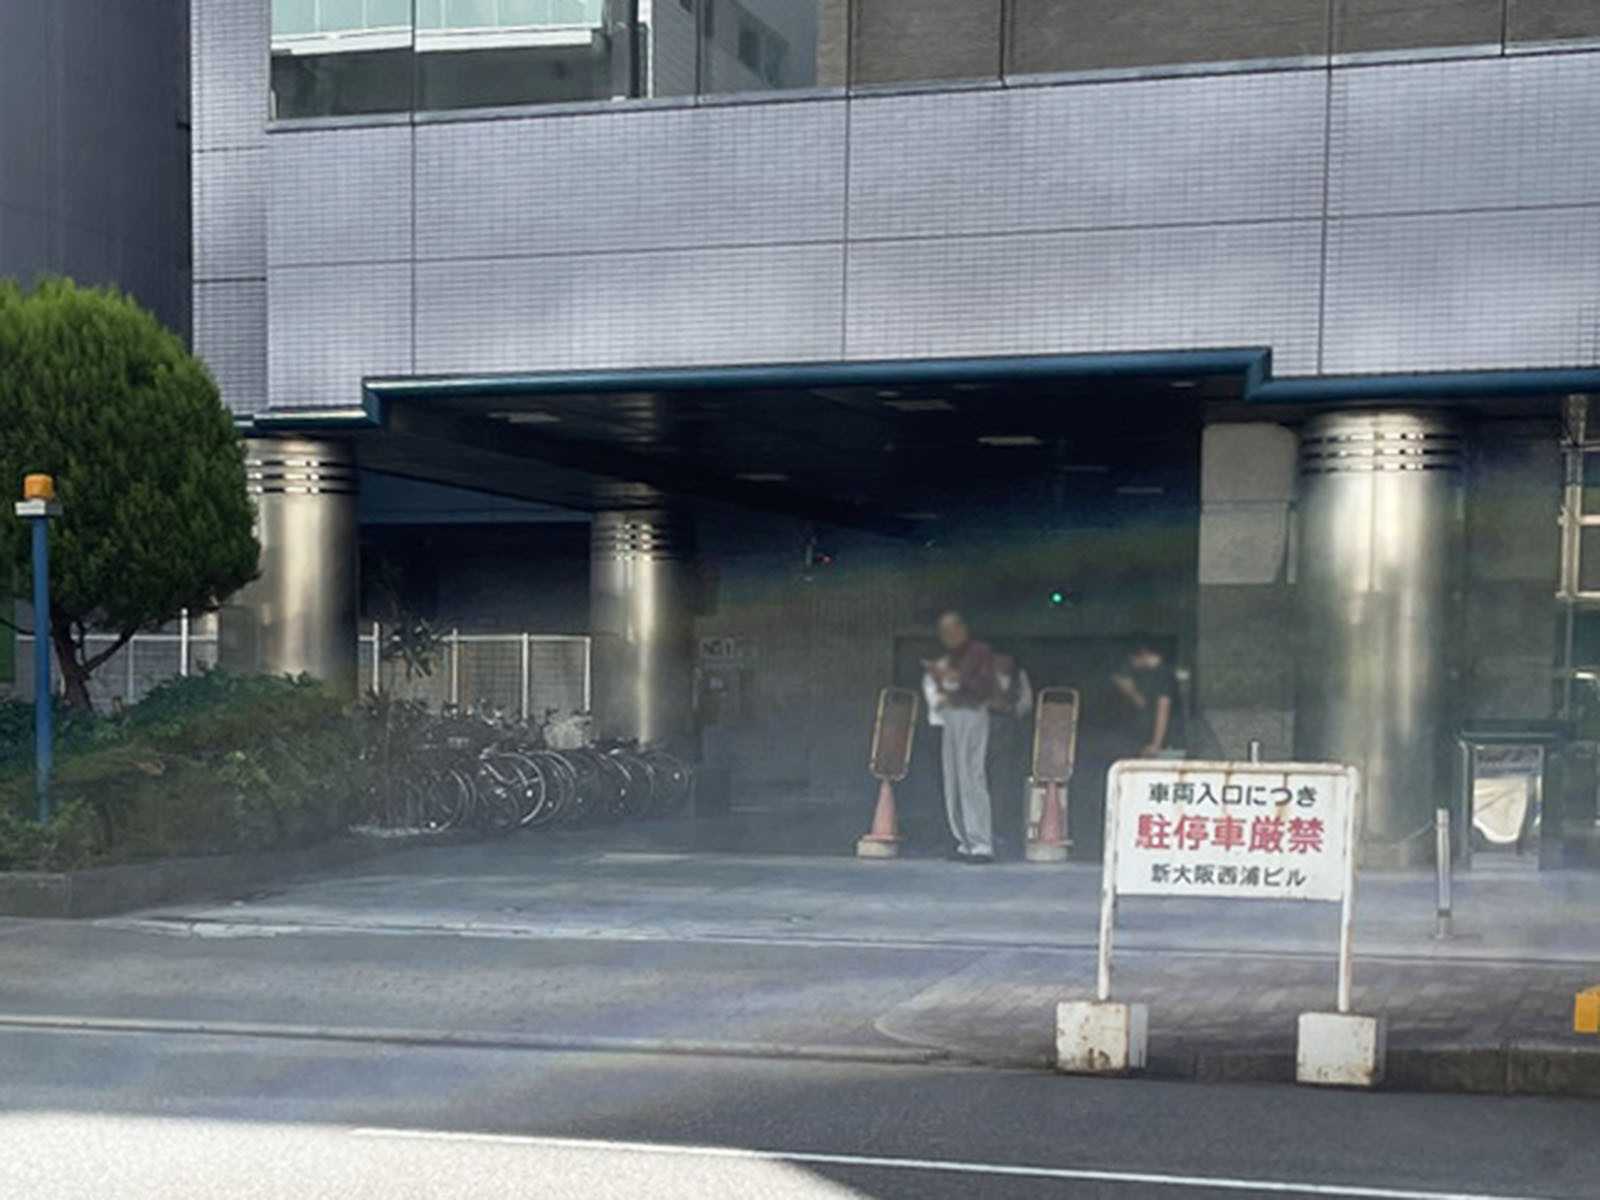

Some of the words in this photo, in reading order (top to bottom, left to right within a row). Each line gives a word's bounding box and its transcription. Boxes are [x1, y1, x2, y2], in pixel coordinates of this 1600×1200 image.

[1148, 782, 1318, 807] 車両入口につき
[1135, 813, 1325, 854] 駐停車厳禁
[1151, 863, 1307, 887] 新大阪西浦ビル
